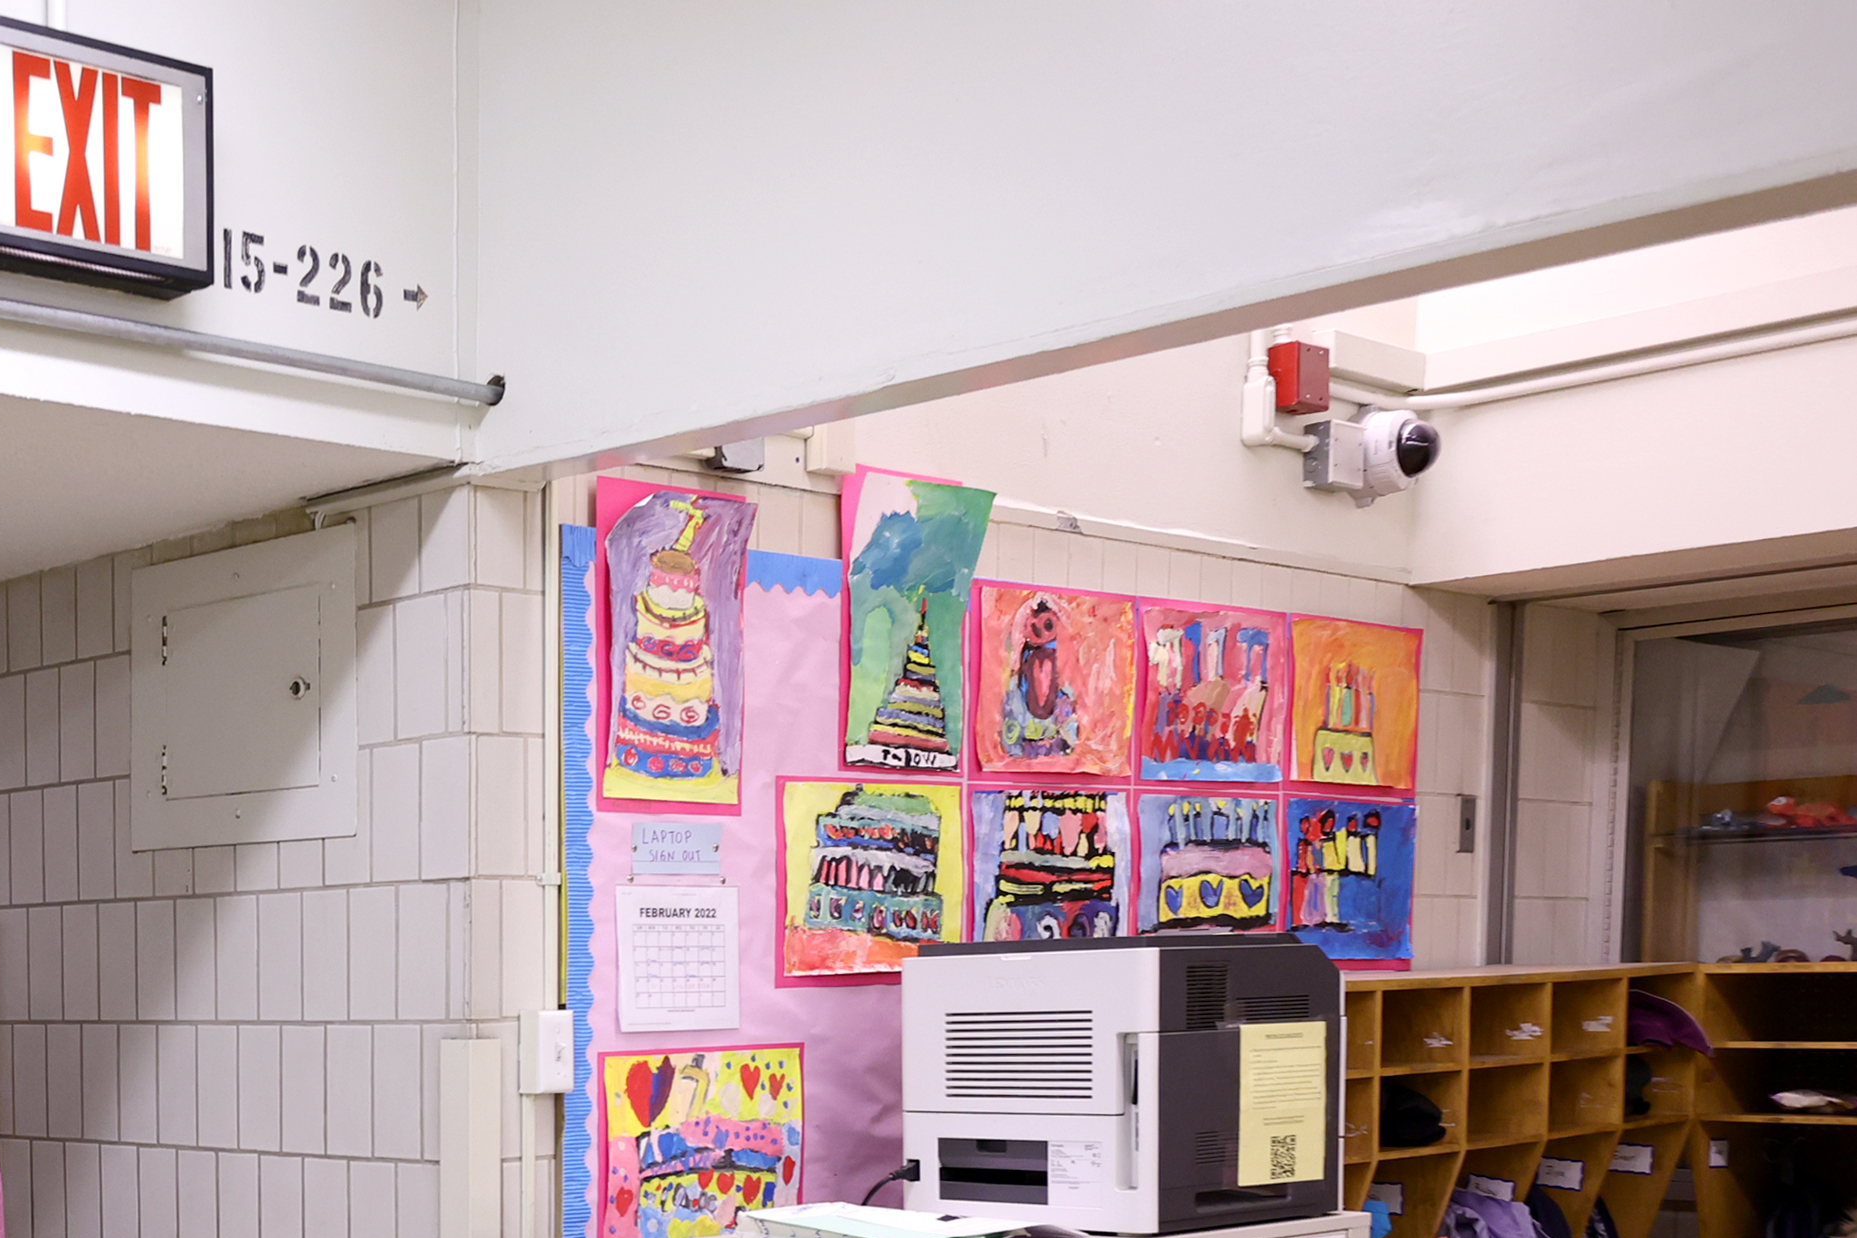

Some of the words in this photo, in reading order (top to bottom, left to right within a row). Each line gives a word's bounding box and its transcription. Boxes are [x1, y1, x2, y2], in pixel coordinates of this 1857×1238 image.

[12, 50, 162, 253] EXIT
[223, 228, 384, 319] 15-226
[642, 828, 692, 844] LAPTOP
[649, 849, 675, 862] SIGN
[682, 850, 701, 862] OUT
[639, 907, 692, 918] FEBRUARY
[694, 908, 717, 918] 2022
